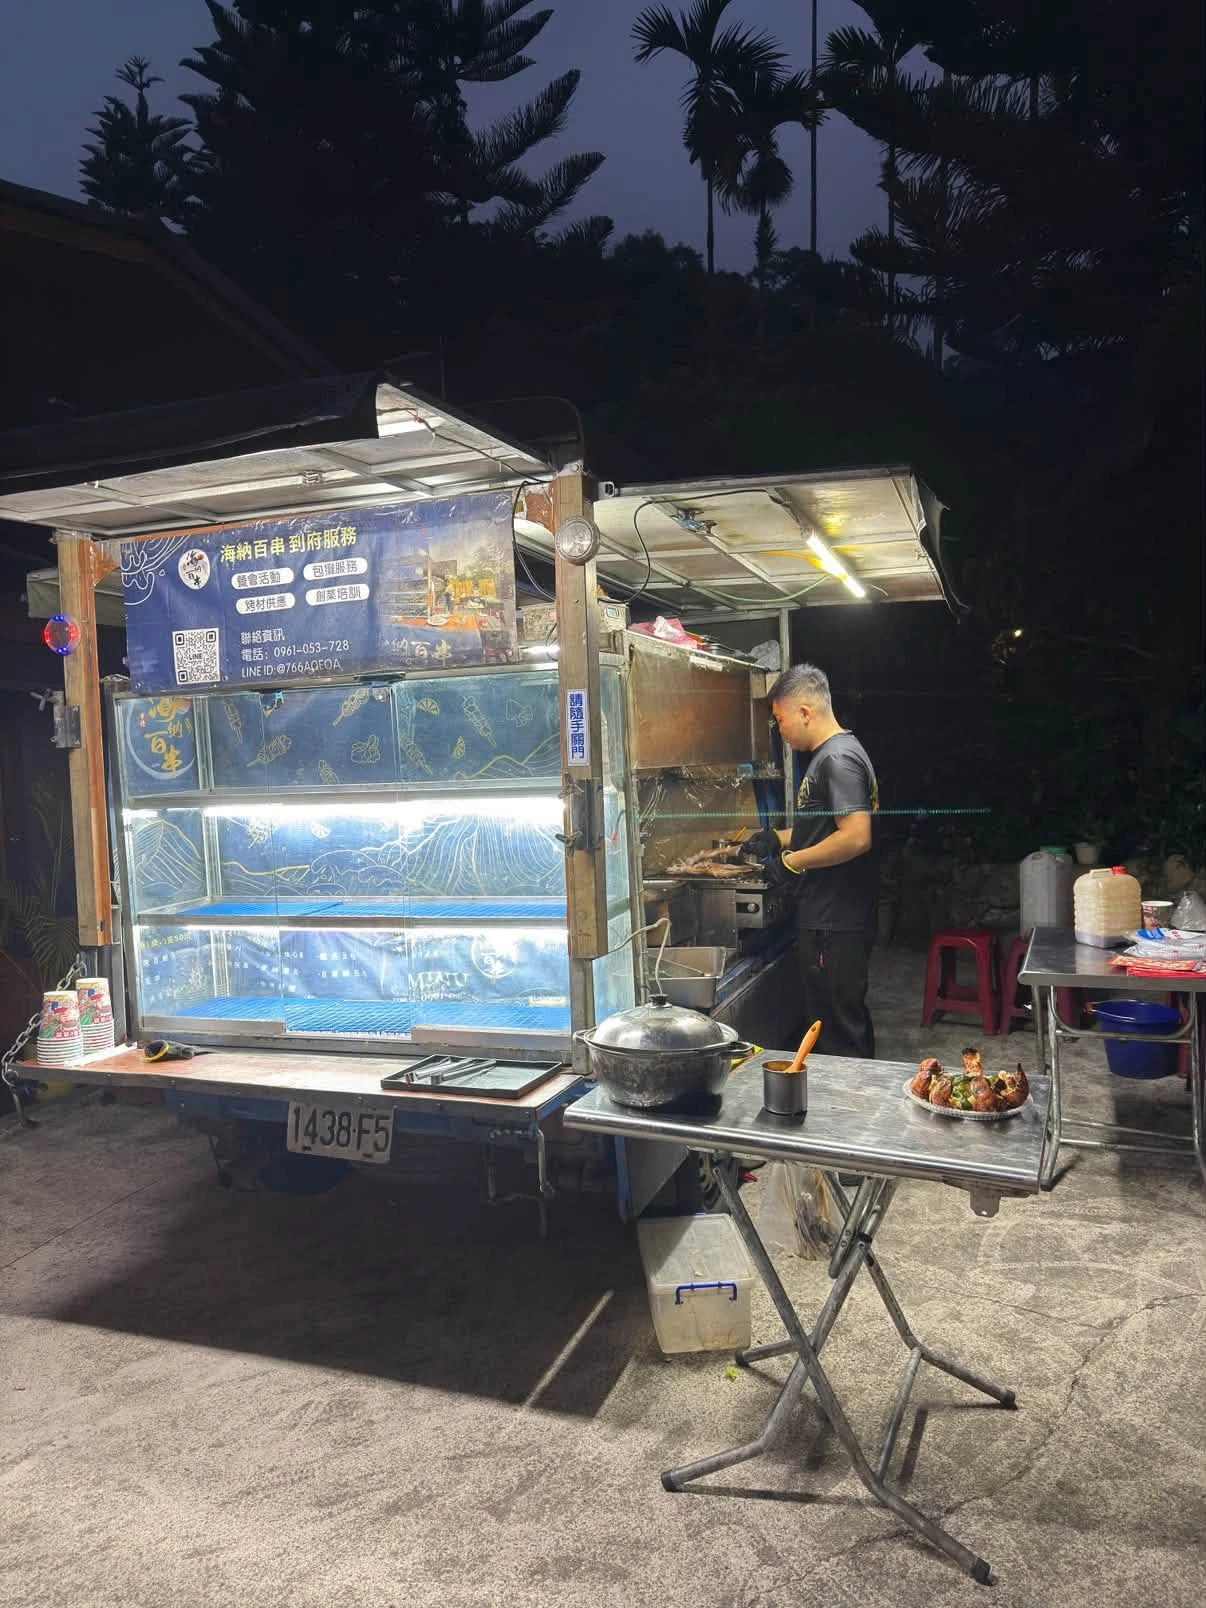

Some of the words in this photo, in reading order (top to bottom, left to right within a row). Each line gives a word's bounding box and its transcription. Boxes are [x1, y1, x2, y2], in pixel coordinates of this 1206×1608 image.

[220, 536, 285, 563] 海納百串
[288, 526, 357, 553] 到府服務
[274, 639, 350, 658] 0961-053-728
[569, 693, 585, 759] 請隨手關門
